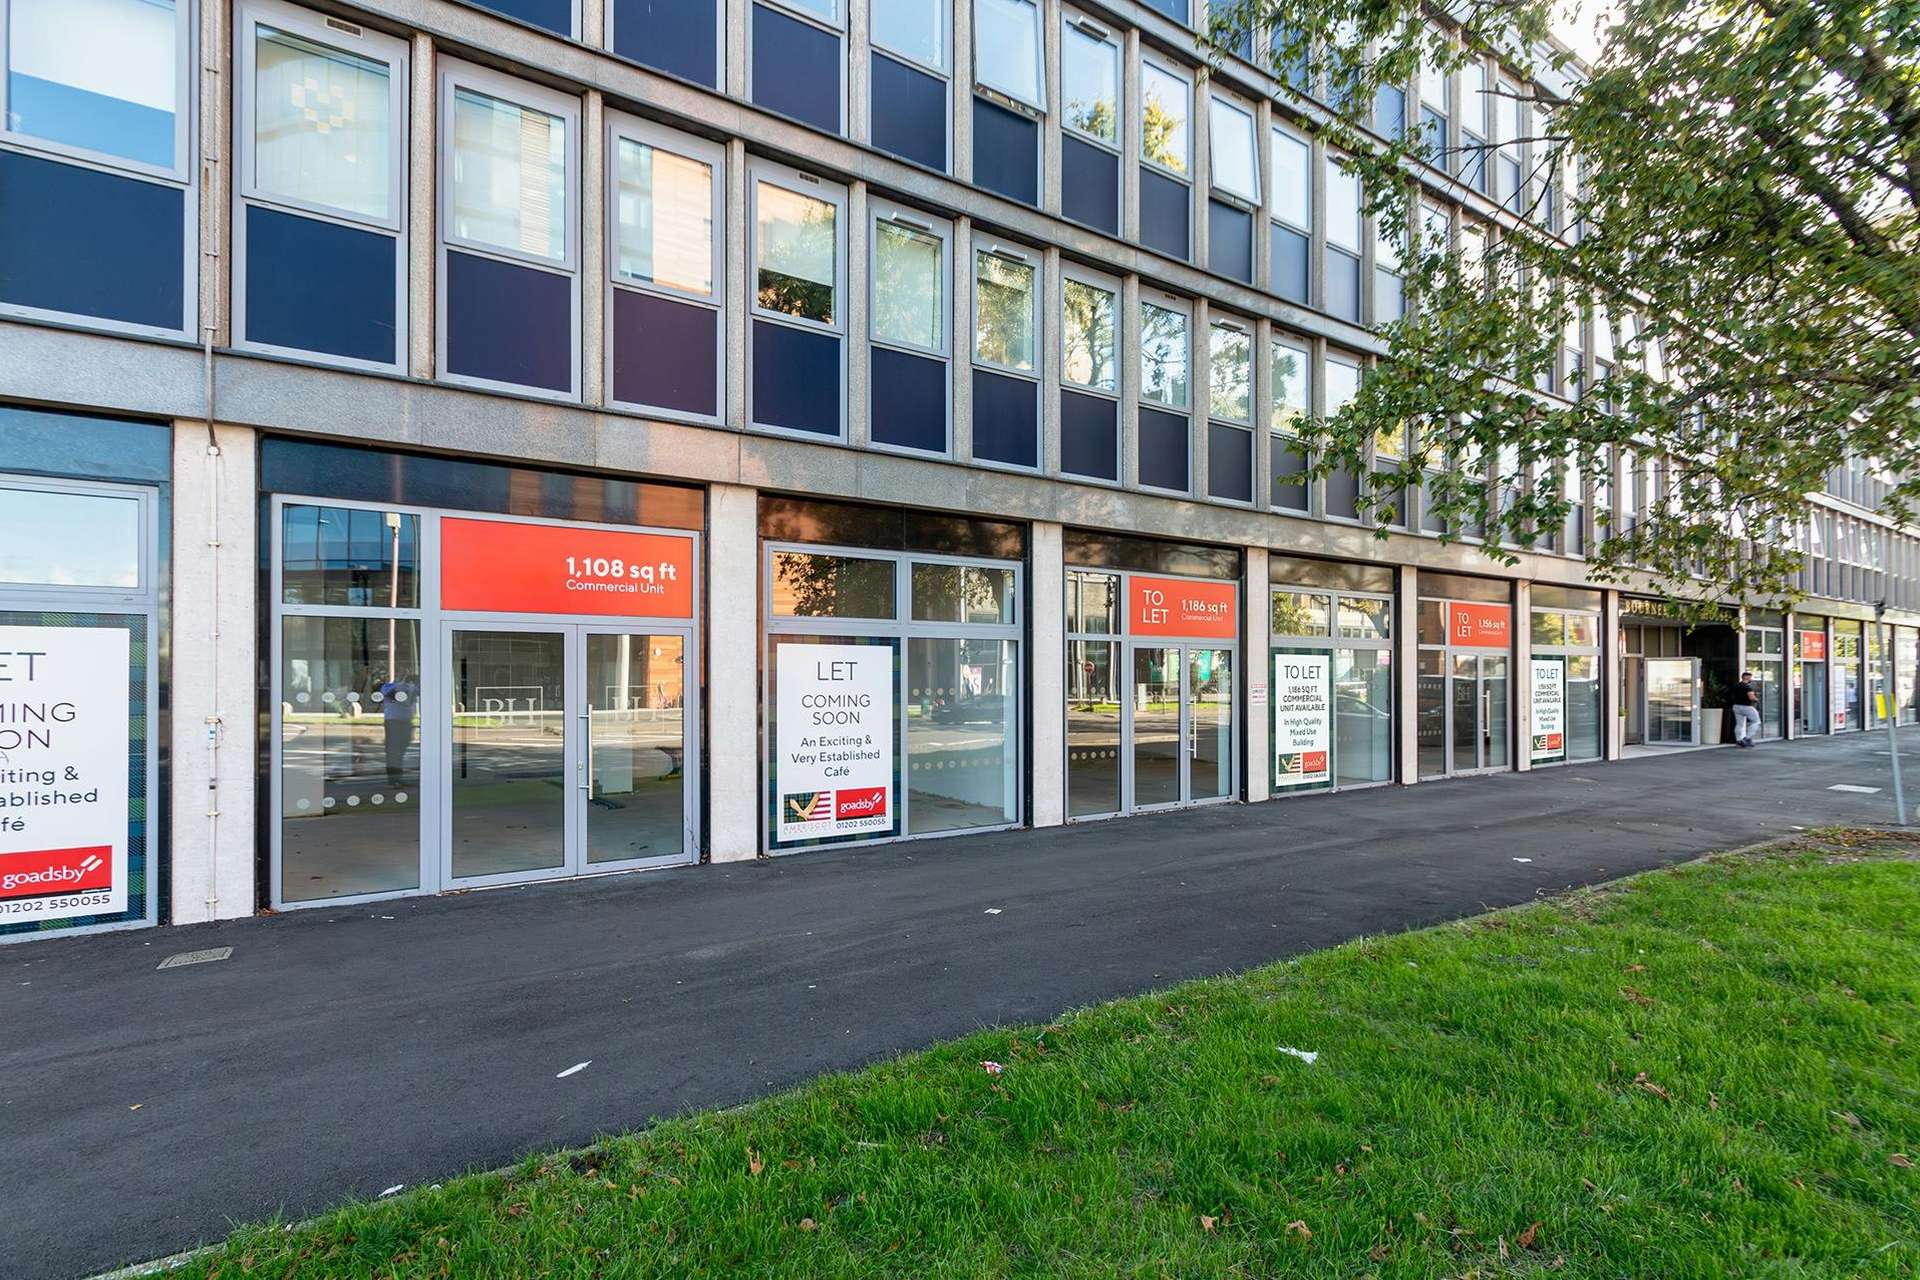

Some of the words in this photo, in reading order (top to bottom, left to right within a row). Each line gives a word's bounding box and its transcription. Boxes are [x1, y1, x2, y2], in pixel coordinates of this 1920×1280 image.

[565, 556, 625, 579] 1,108
[629, 564, 654, 583] sq
[658, 562, 677, 580] ft
[566, 579, 638, 594] Commercial
[640, 582, 665, 595] Unit
[1143, 589, 1165, 606] TO
[1181, 599, 1206, 613] 1,186
[1207, 603, 1219, 615] sq
[1219, 601, 1228, 614] ft
[1142, 608, 1169, 625] LET
[1457, 612, 1470, 625] TO
[1457, 625, 1472, 638] LET
[817, 661, 858, 681] LET
[1284, 665, 1299, 679] TO
[1302, 665, 1321, 679] LET
[1536, 668, 1545, 679] TO
[1546, 668, 1559, 679] LET
[801, 693, 871, 709] COMING
[1283, 694, 1323, 703] COMMERCIAL
[0, 702, 76, 723] ING
[1295, 703, 1326, 711] AVAILABLE
[812, 711, 860, 725] SOON
[800, 737, 816, 748] An
[819, 735, 862, 749] Exciting
[864, 734, 872, 745] &
[791, 753, 817, 766] Very
[819, 750, 880, 763] Established
[64, 765, 80, 782] &
[824, 766, 850, 778] Café
[840, 798, 876, 814] goadsby
[836, 820, 858, 830] 01202
[859, 818, 886, 828] 550055
[2, 864, 86, 890] goadsby
[49, 894, 111, 909] 550055
